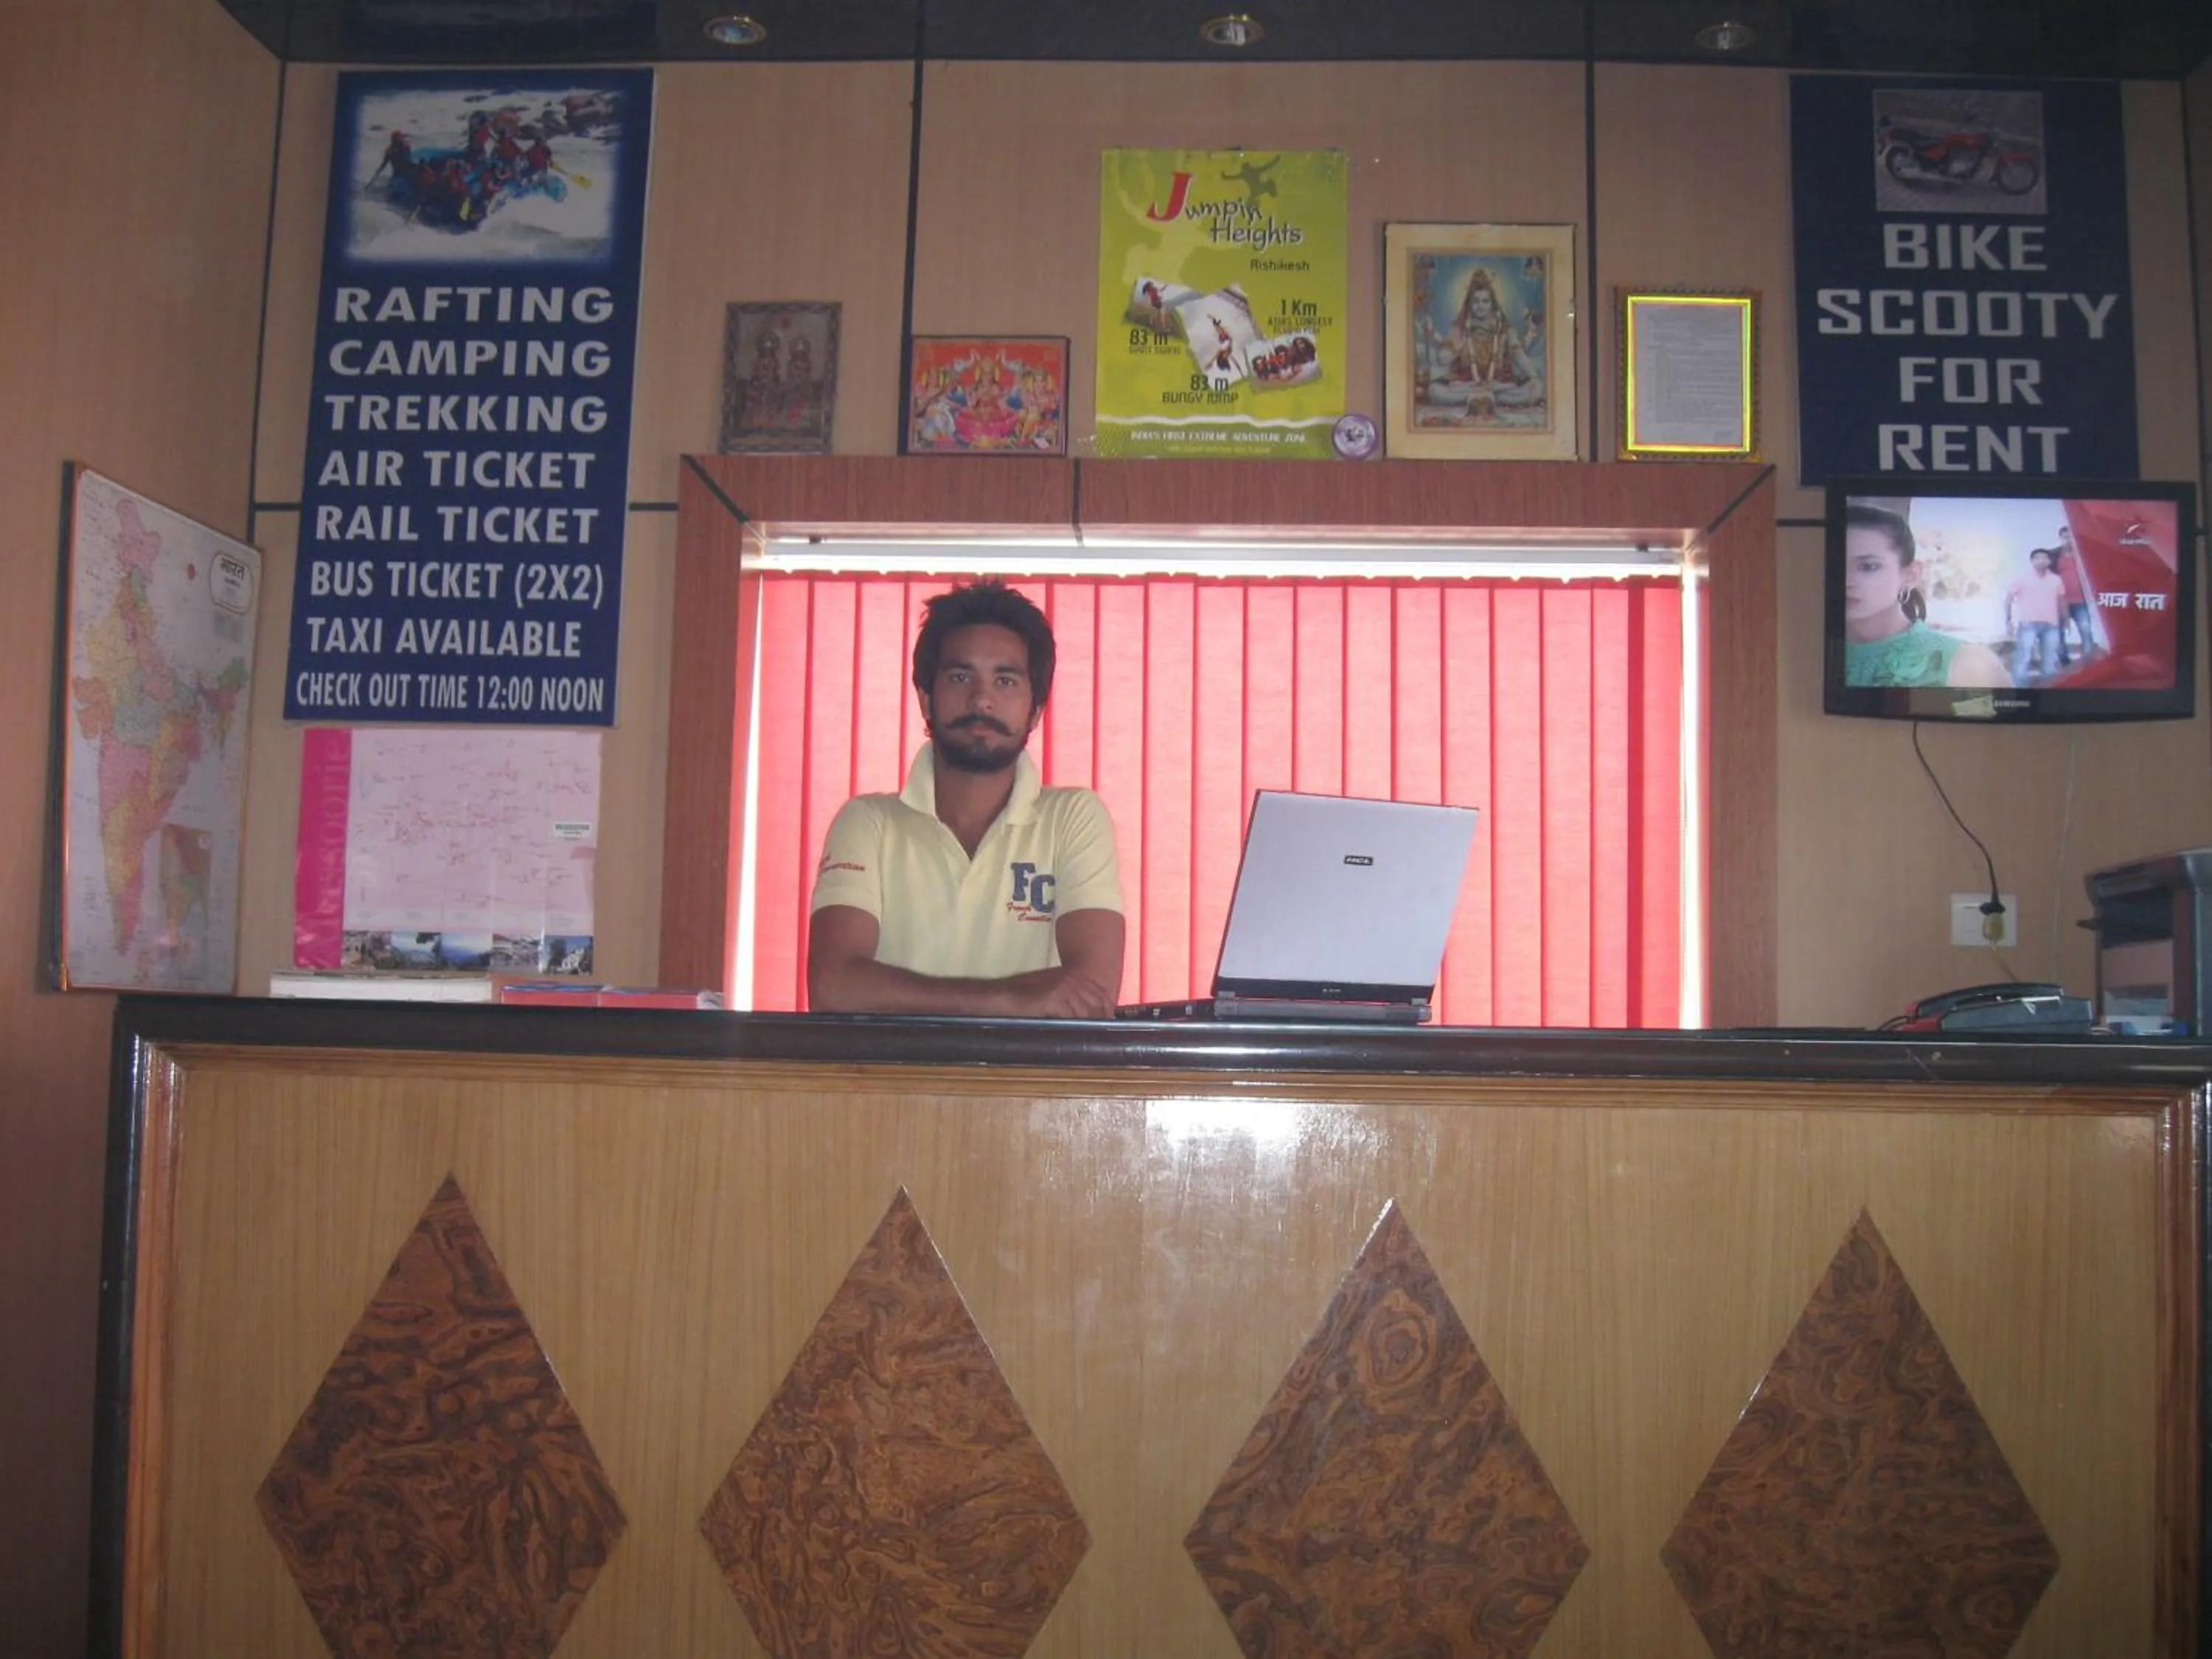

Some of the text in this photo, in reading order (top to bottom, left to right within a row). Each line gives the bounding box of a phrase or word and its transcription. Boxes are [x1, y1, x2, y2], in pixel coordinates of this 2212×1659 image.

[1146, 171, 1262, 223] Jumpin
[1209, 216, 1303, 251] Heights
[1882, 223, 2048, 271] BIKE
[334, 286, 614, 323] RAFTING
[1292, 299, 1317, 316] Km
[1816, 288, 2118, 339] SCOOTY
[1130, 329, 1168, 345] 83 m
[328, 339, 612, 377] CAMPING
[1191, 375, 1228, 392] 83 m
[1899, 356, 2042, 405] FOR
[324, 394, 608, 432] TREKKING
[1879, 423, 2070, 473] RENT
[318, 450, 596, 490] AIR TICKET
[316, 505, 599, 544] RAIL TICKET
[310, 560, 603, 609] BUS TICKET (2X2)
[2097, 592, 2167, 611] आज रात
[307, 616, 582, 658] TAXI AVAILABLE
[296, 671, 604, 712] CHECK OUT TIME 12:00 NOON
